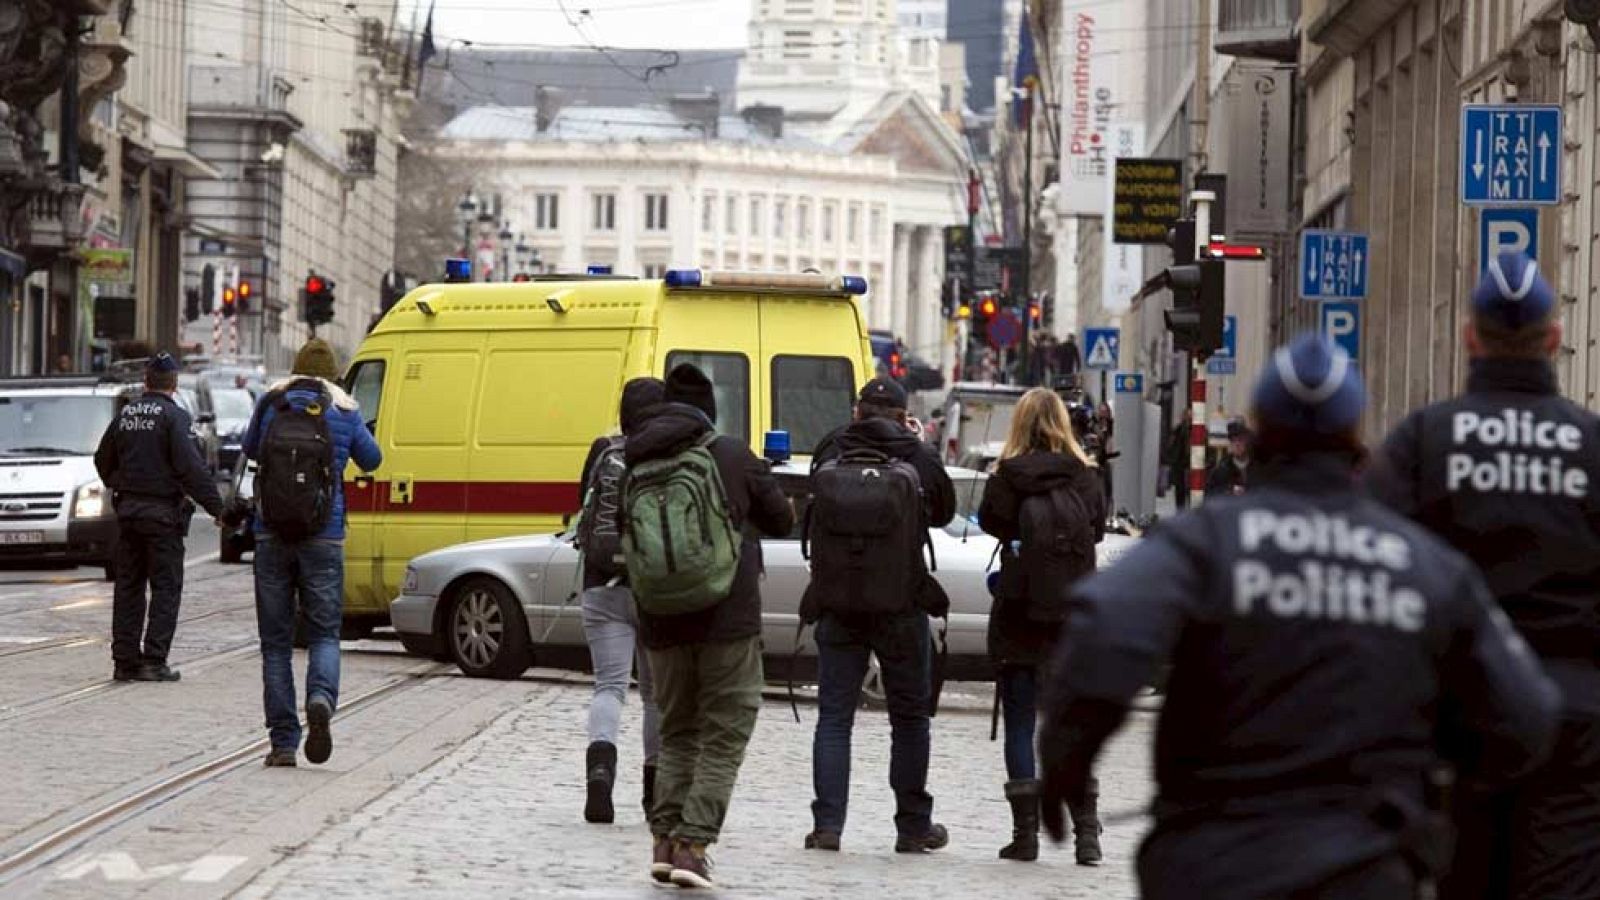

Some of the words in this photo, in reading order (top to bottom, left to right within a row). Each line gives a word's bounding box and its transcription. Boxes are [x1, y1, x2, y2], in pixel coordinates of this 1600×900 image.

[1071, 12, 1095, 154] Philanthropy
[1493, 113, 1511, 199] TRAM
[1514, 113, 1529, 199] TAXI
[1488, 220, 1531, 262] P
[1326, 311, 1356, 350] P
[119, 416, 156, 431] Police
[121, 402, 163, 416] Politie
[1452, 408, 1583, 450] Police
[1447, 451, 1589, 498] Politie
[1239, 508, 1410, 571] Police
[1233, 557, 1425, 632] Politie
